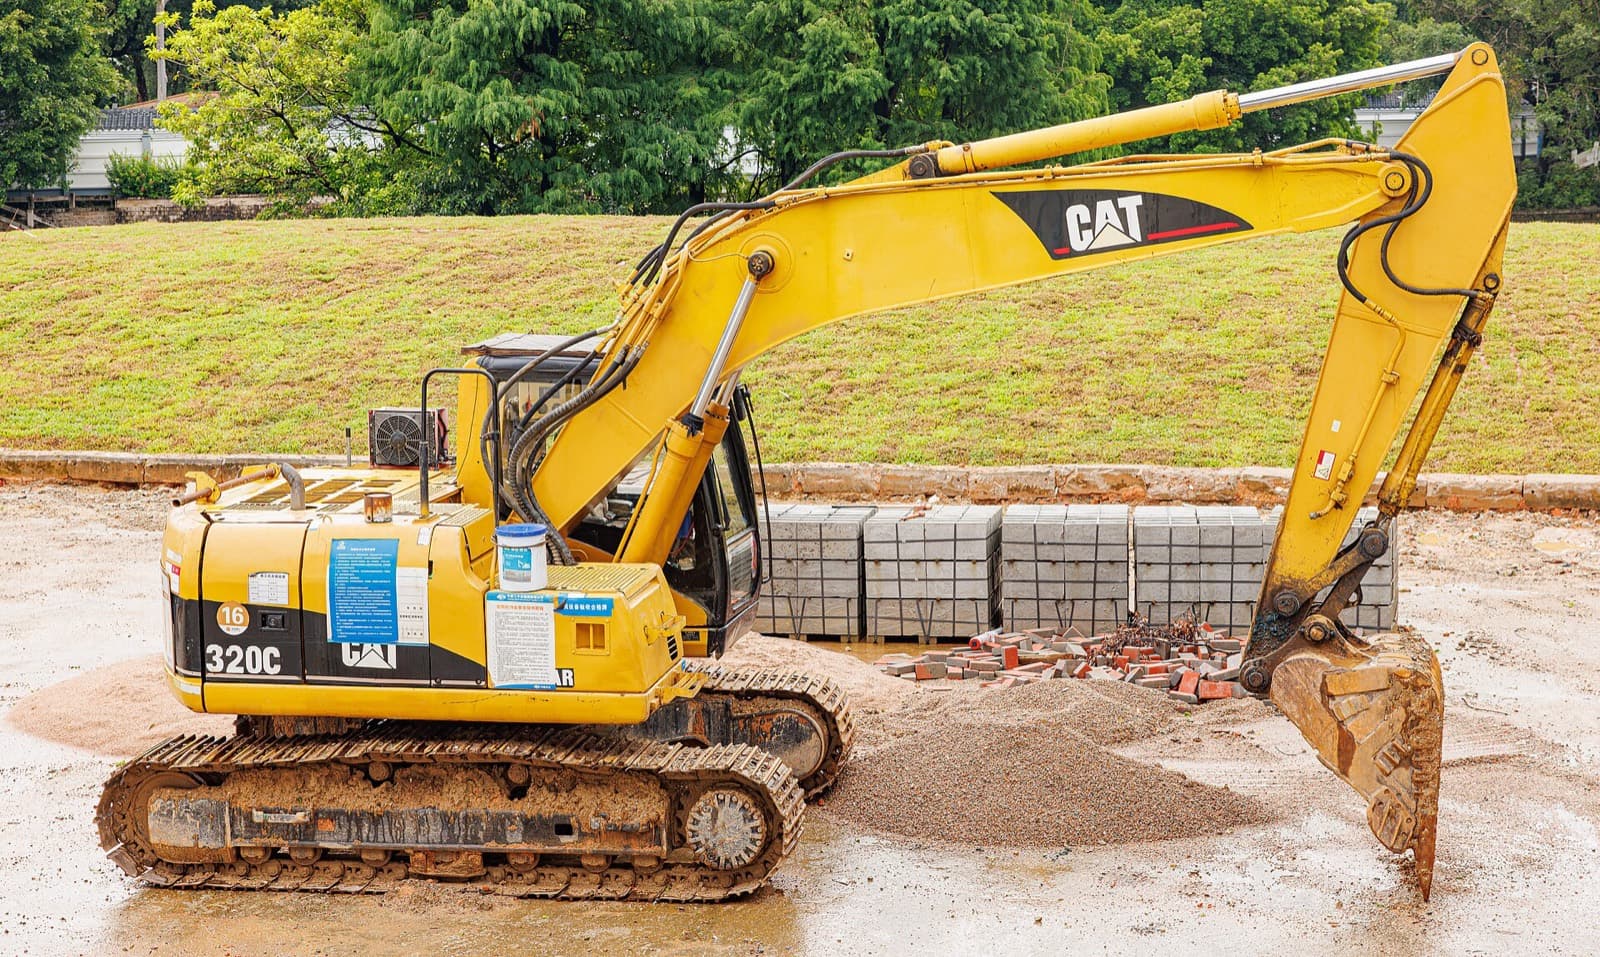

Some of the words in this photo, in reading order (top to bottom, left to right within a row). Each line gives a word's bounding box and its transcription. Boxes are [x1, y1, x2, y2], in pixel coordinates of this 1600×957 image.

[1065, 194, 1143, 252] CAT
[222, 606, 244, 624] 16
[206, 644, 281, 675] 320C
